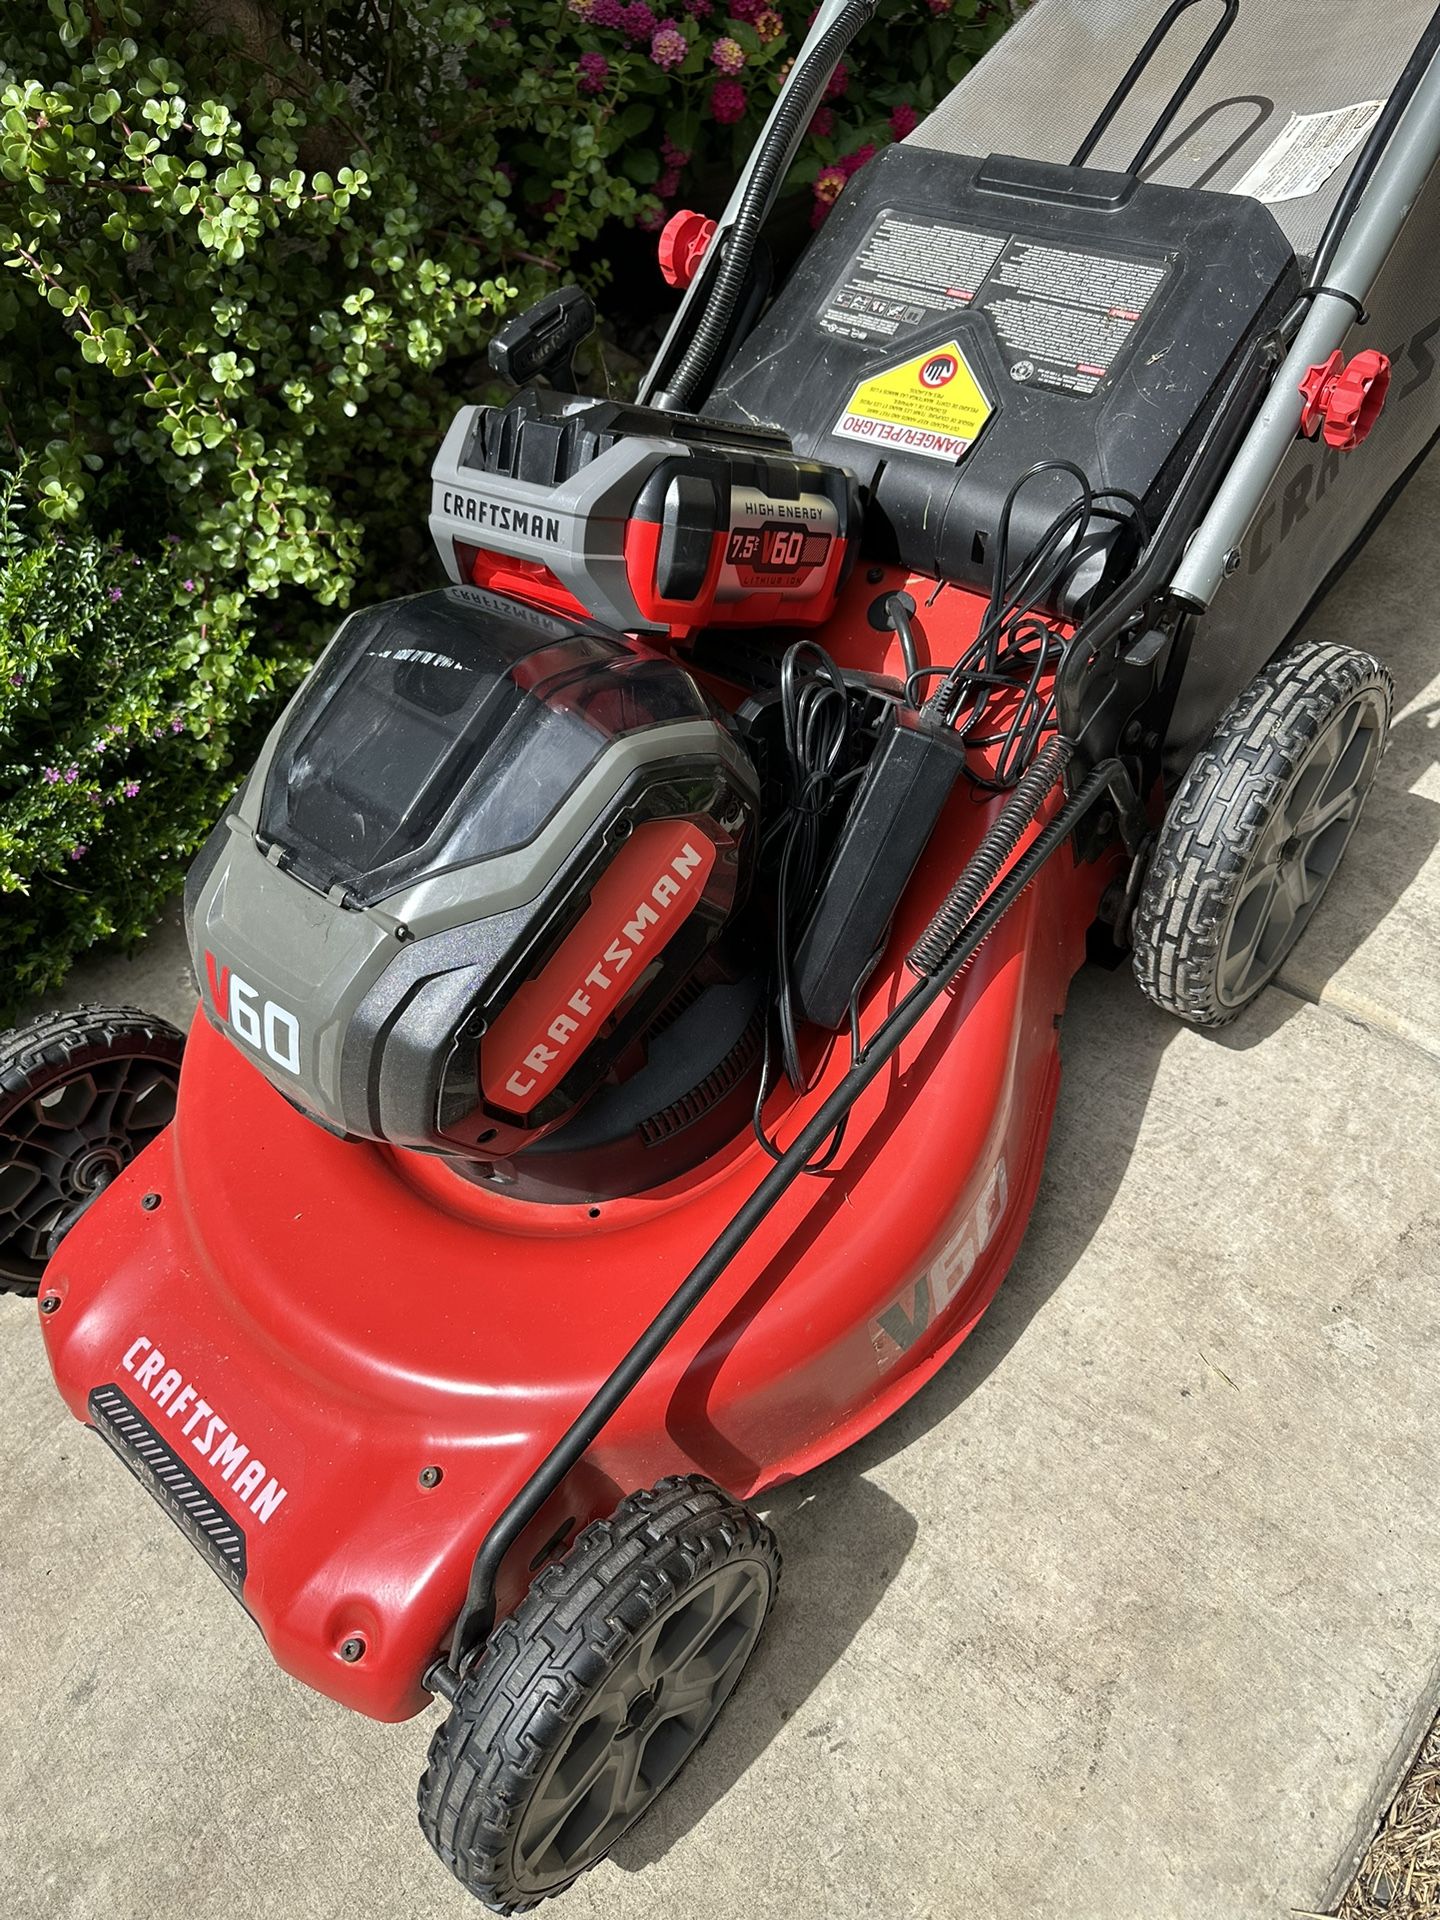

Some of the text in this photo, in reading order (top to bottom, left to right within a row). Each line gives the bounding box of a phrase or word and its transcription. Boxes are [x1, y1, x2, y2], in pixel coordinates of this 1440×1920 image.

[443, 491, 561, 542] CRAFTSMAN
[745, 502, 823, 520] HIGH ENERGY
[761, 530, 804, 565] V60
[204, 948, 300, 1076] V60
[506, 842, 703, 1097] CRAFTSMAN
[122, 1336, 288, 1524] CRAFTSMAN
